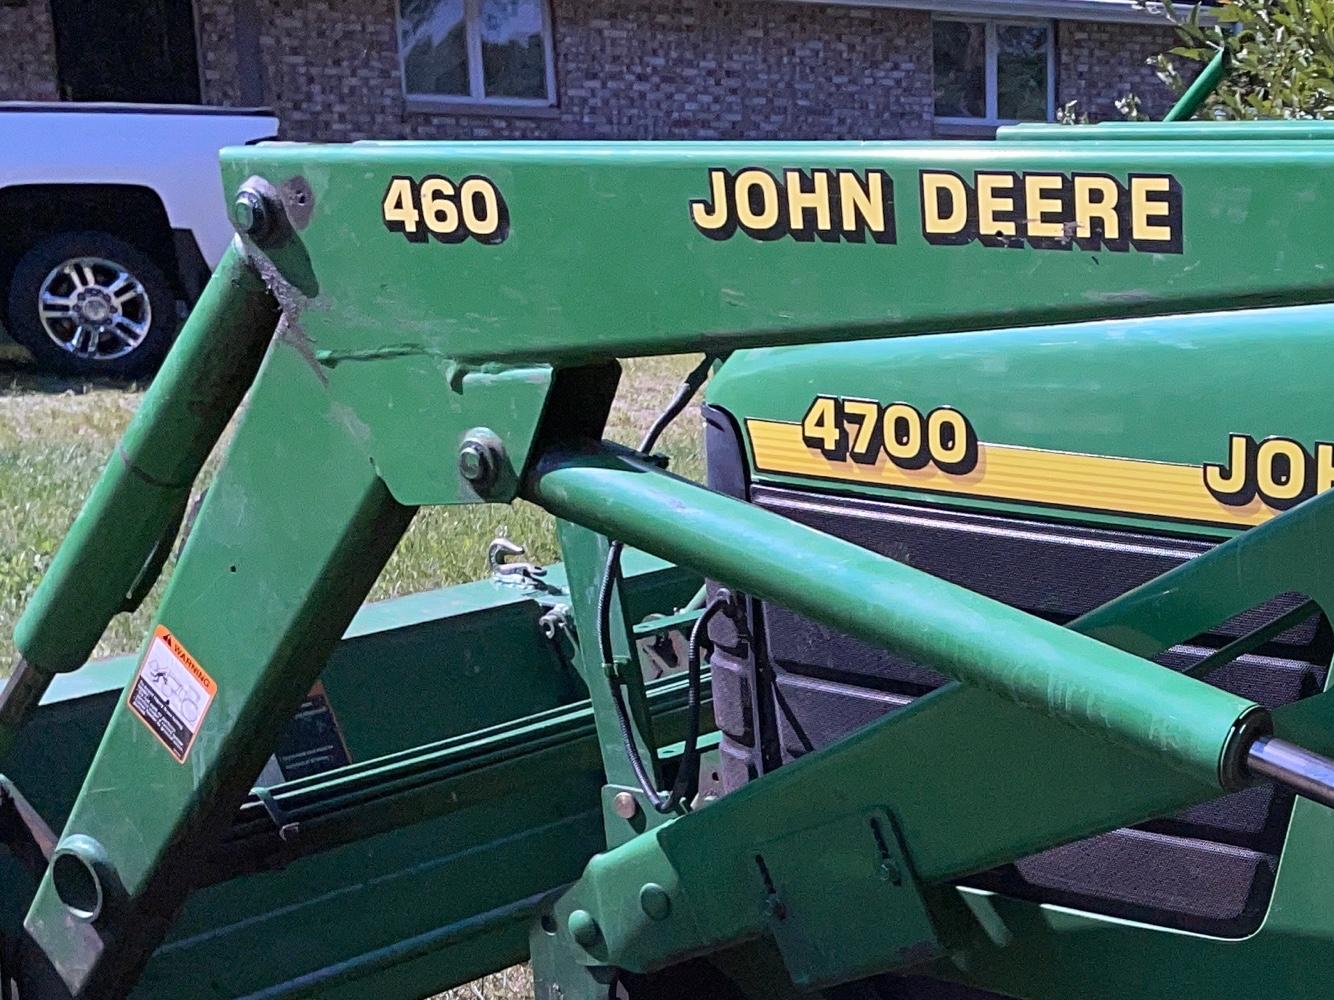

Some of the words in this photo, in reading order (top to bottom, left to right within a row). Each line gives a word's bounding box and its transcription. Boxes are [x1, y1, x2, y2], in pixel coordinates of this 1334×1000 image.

[382, 176, 510, 243] 460
[690, 167, 896, 244] JOHN
[921, 170, 1183, 254] DEERE
[801, 395, 977, 475] 4700
[174, 644, 210, 688] WARNING
